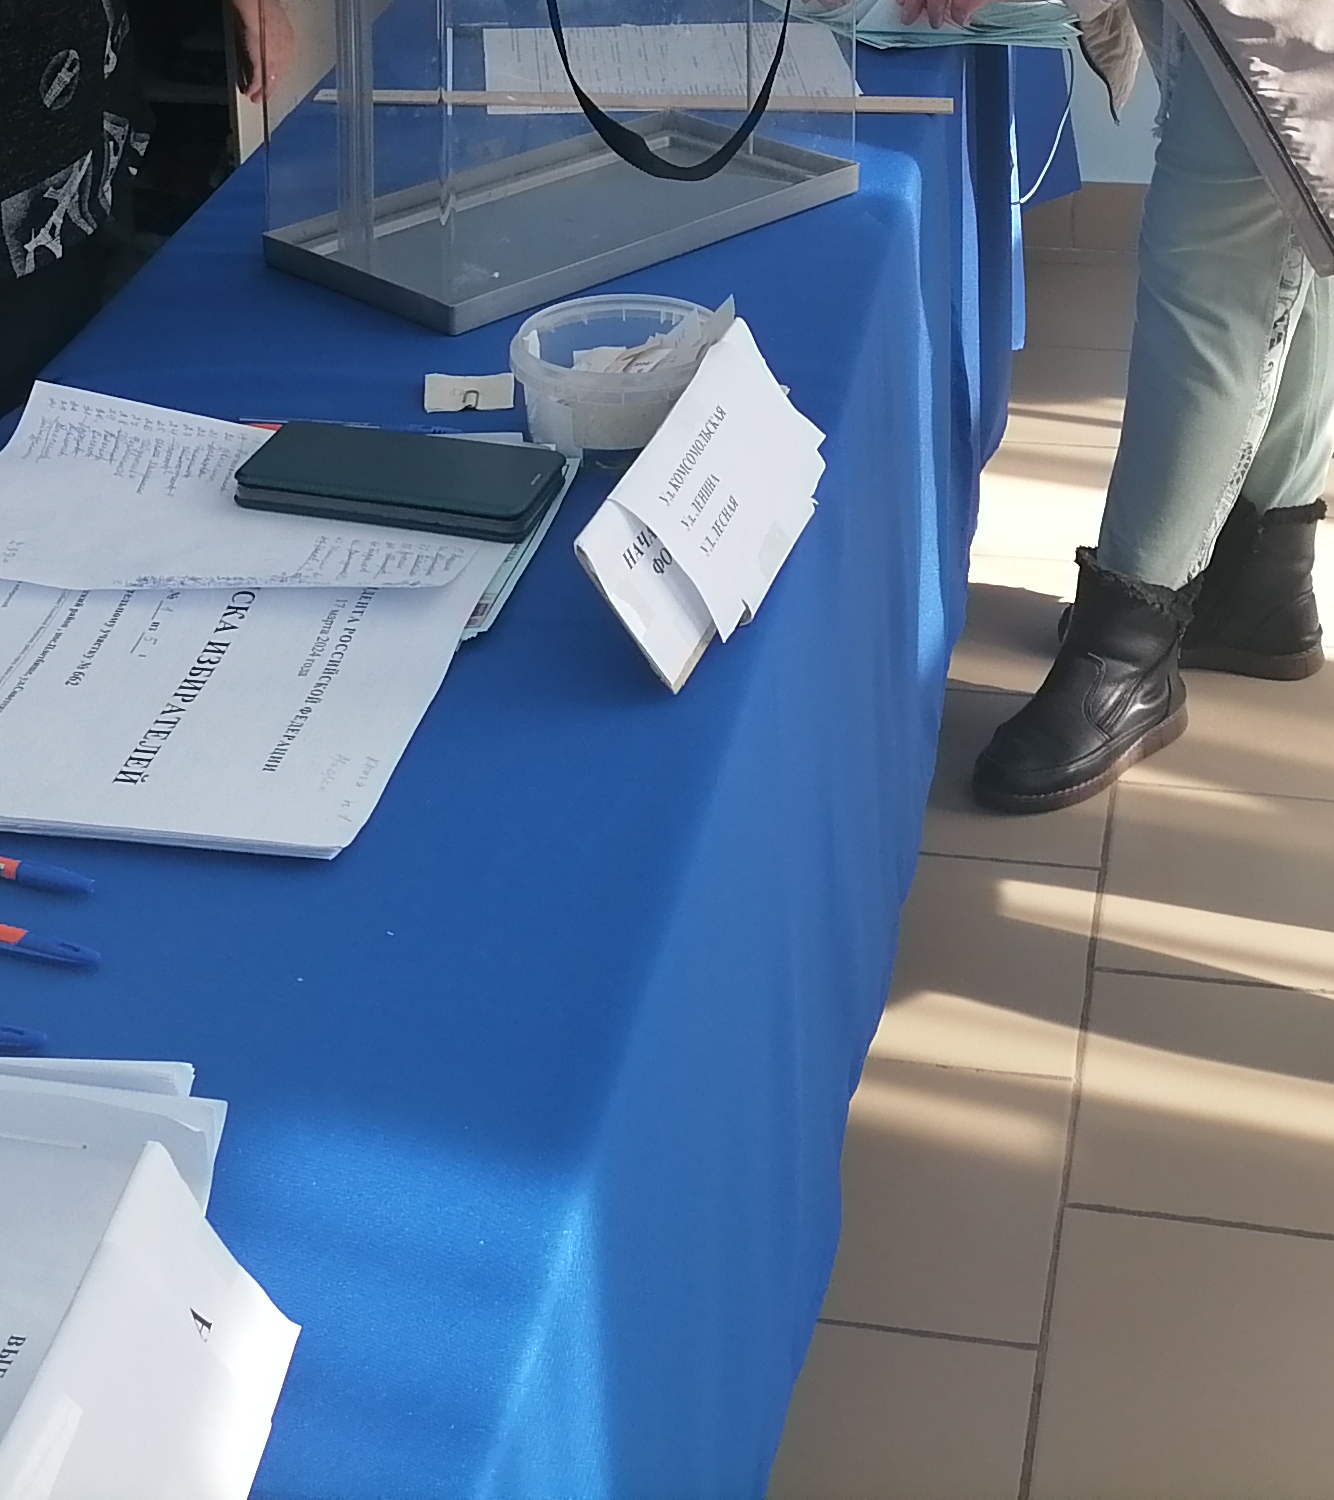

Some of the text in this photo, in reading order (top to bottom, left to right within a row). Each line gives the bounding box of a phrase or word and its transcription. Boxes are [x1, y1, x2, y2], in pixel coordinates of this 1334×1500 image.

[622, 525, 658, 570] НАЧА
[652, 547, 673, 576] ФО
[104, 589, 136, 628] тельному
[213, 587, 261, 634] СКА
[335, 599, 348, 609] 17
[347, 587, 379, 624] ДЕНТА
[305, 626, 357, 705] РОССИЙСКОЙ
[312, 635, 330, 658] 2024
[64, 670, 85, 687] 662
[111, 640, 232, 785] ИЗБИРАТЕЛЕЙ
[262, 706, 313, 772] ФЕДЕРАЦИИ
